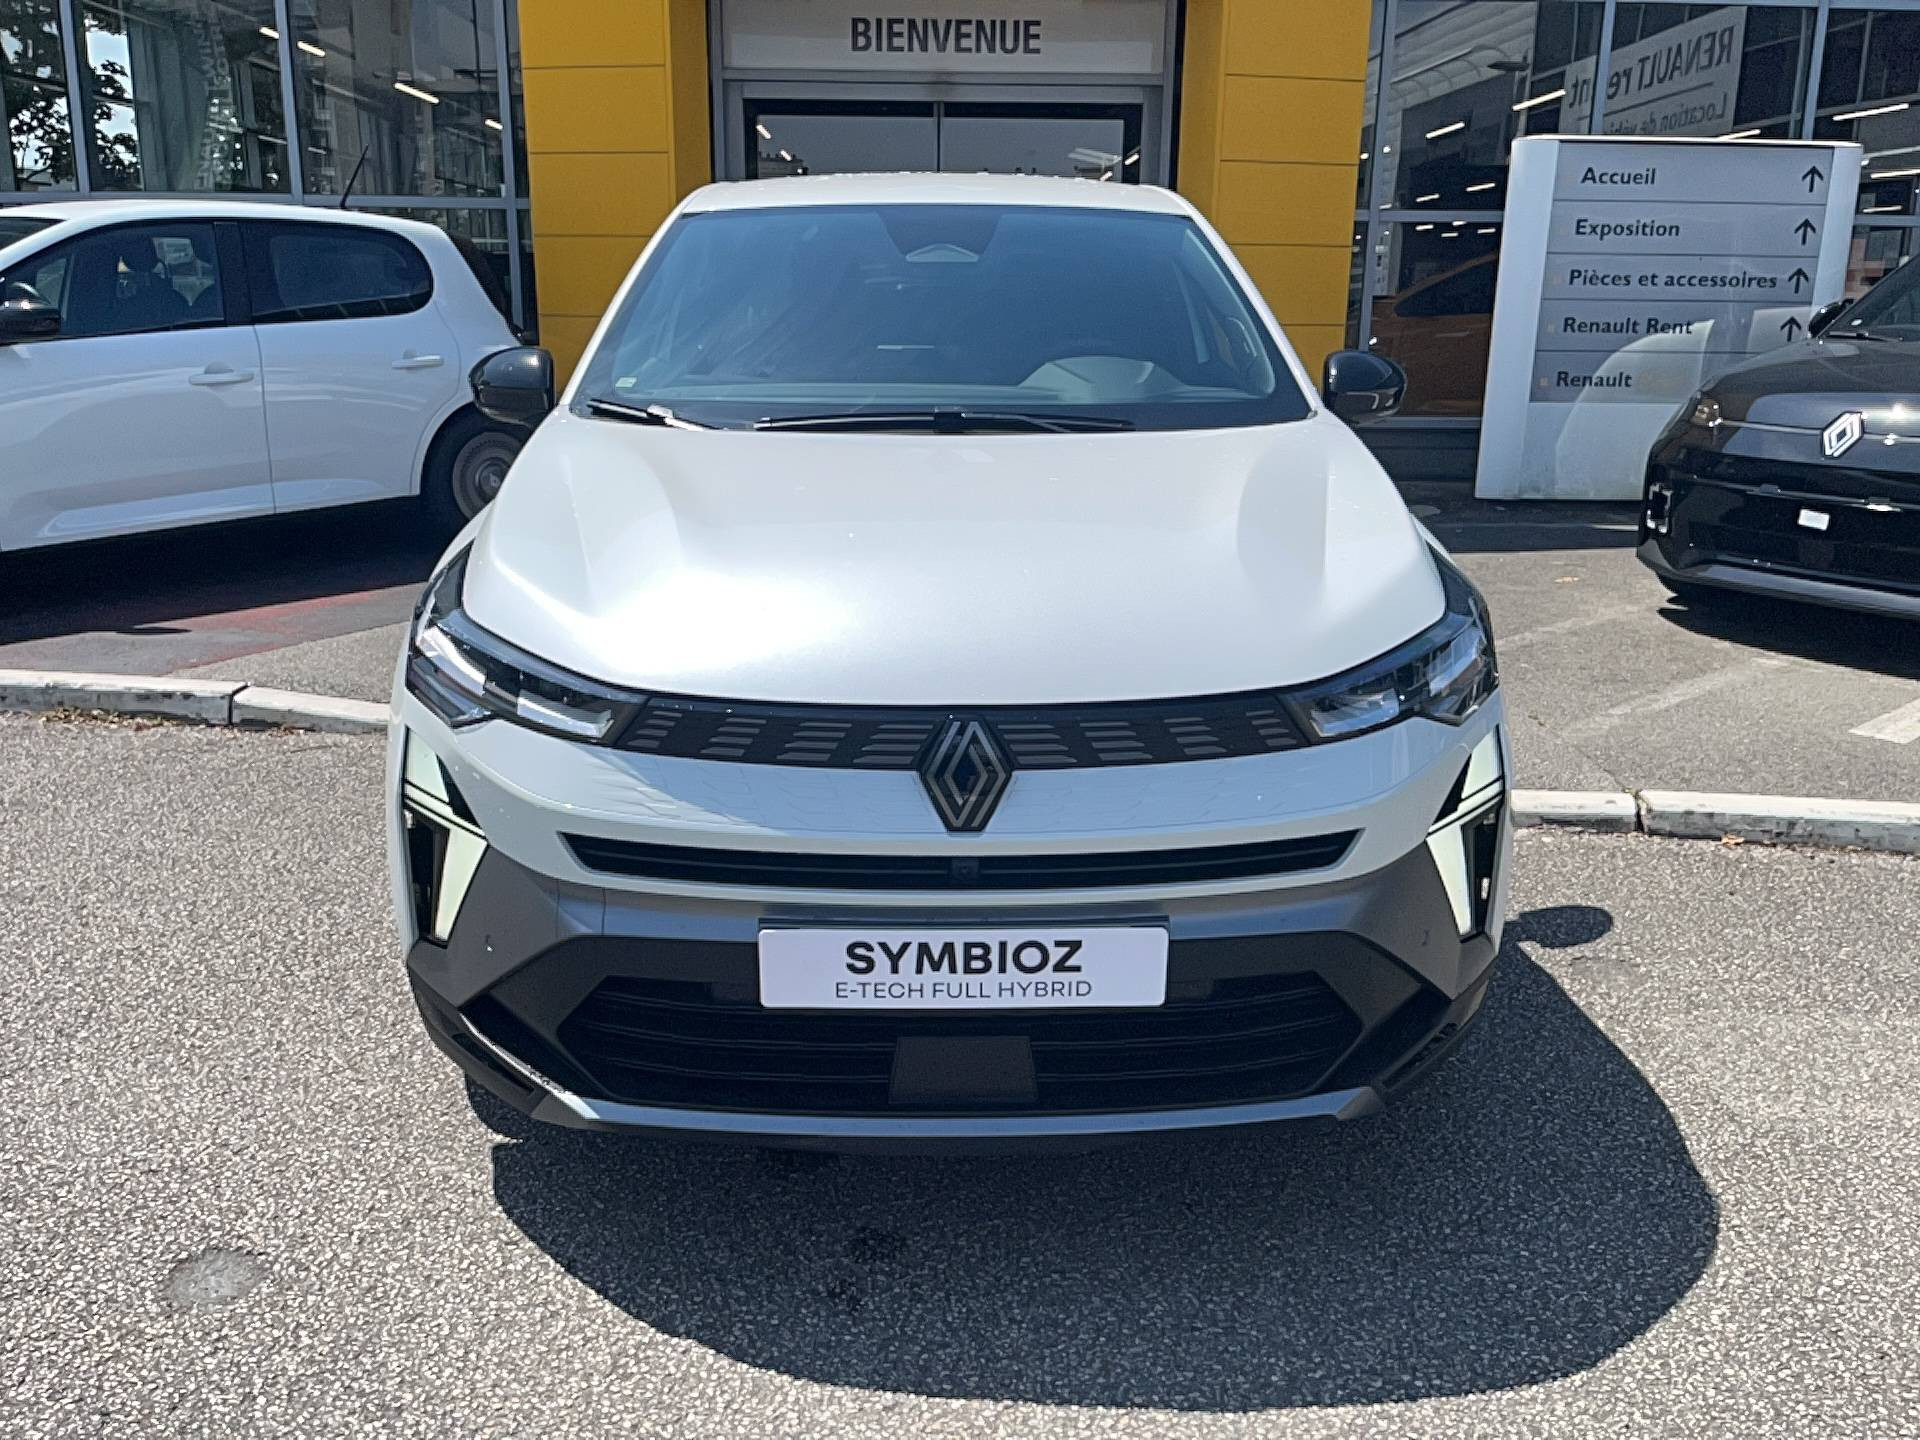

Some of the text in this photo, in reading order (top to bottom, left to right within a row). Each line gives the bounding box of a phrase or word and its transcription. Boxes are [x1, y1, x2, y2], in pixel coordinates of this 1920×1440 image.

[851, 17, 1041, 54] BIENVENUE
[1580, 166, 1656, 186] Accueil
[1574, 219, 1680, 242] Exposition
[1568, 269, 1778, 290] Pièces et accessoires
[1562, 317, 1693, 335] Renault Rent
[1556, 371, 1633, 389] Renault
[845, 940, 1083, 975] SYMBIOZ
[835, 980, 1092, 999] E-TECH FULL HYBRID
